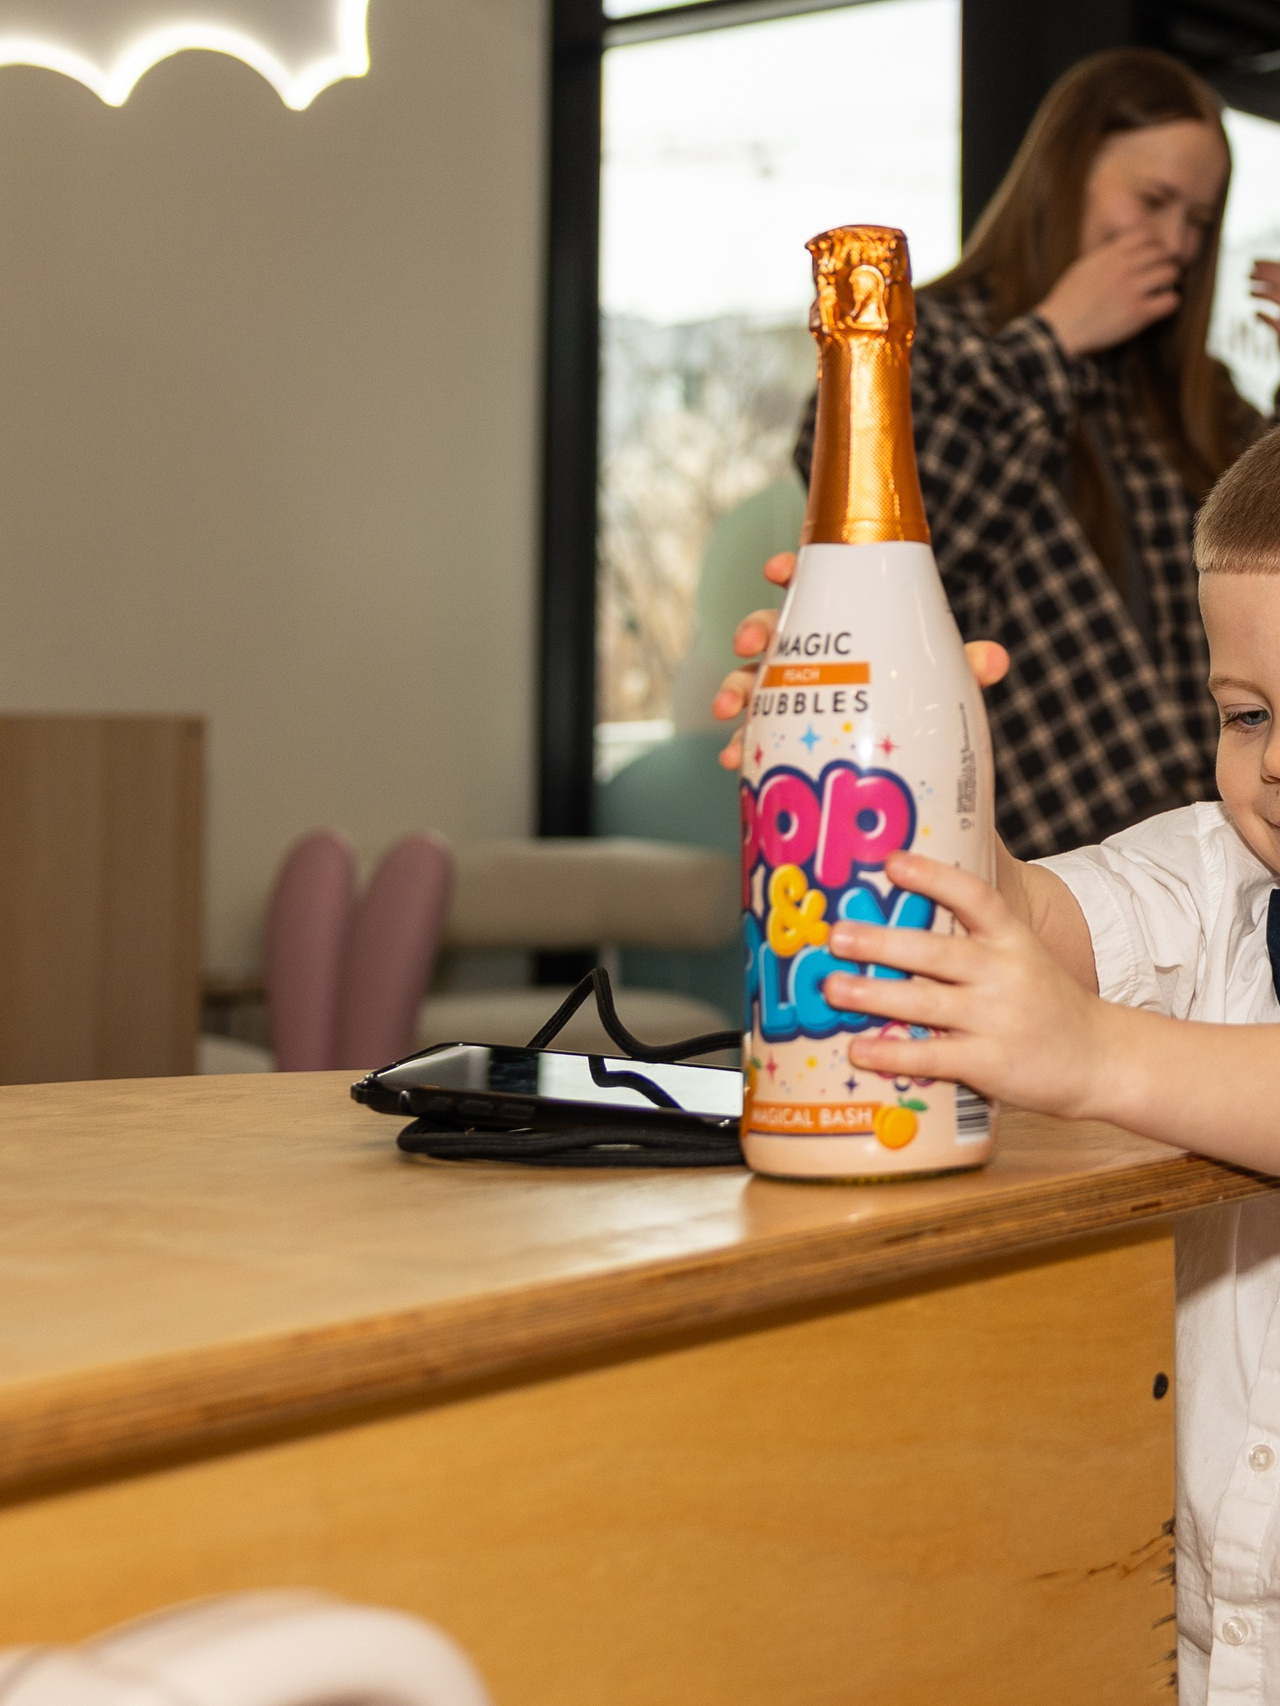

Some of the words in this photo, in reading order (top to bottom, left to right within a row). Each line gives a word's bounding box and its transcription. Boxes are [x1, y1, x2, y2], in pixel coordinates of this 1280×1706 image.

[775, 631, 852, 657] MAGIC
[752, 690, 870, 716] BUBBLES
[766, 863, 832, 958] &
[818, 1106, 874, 1128] BASH
